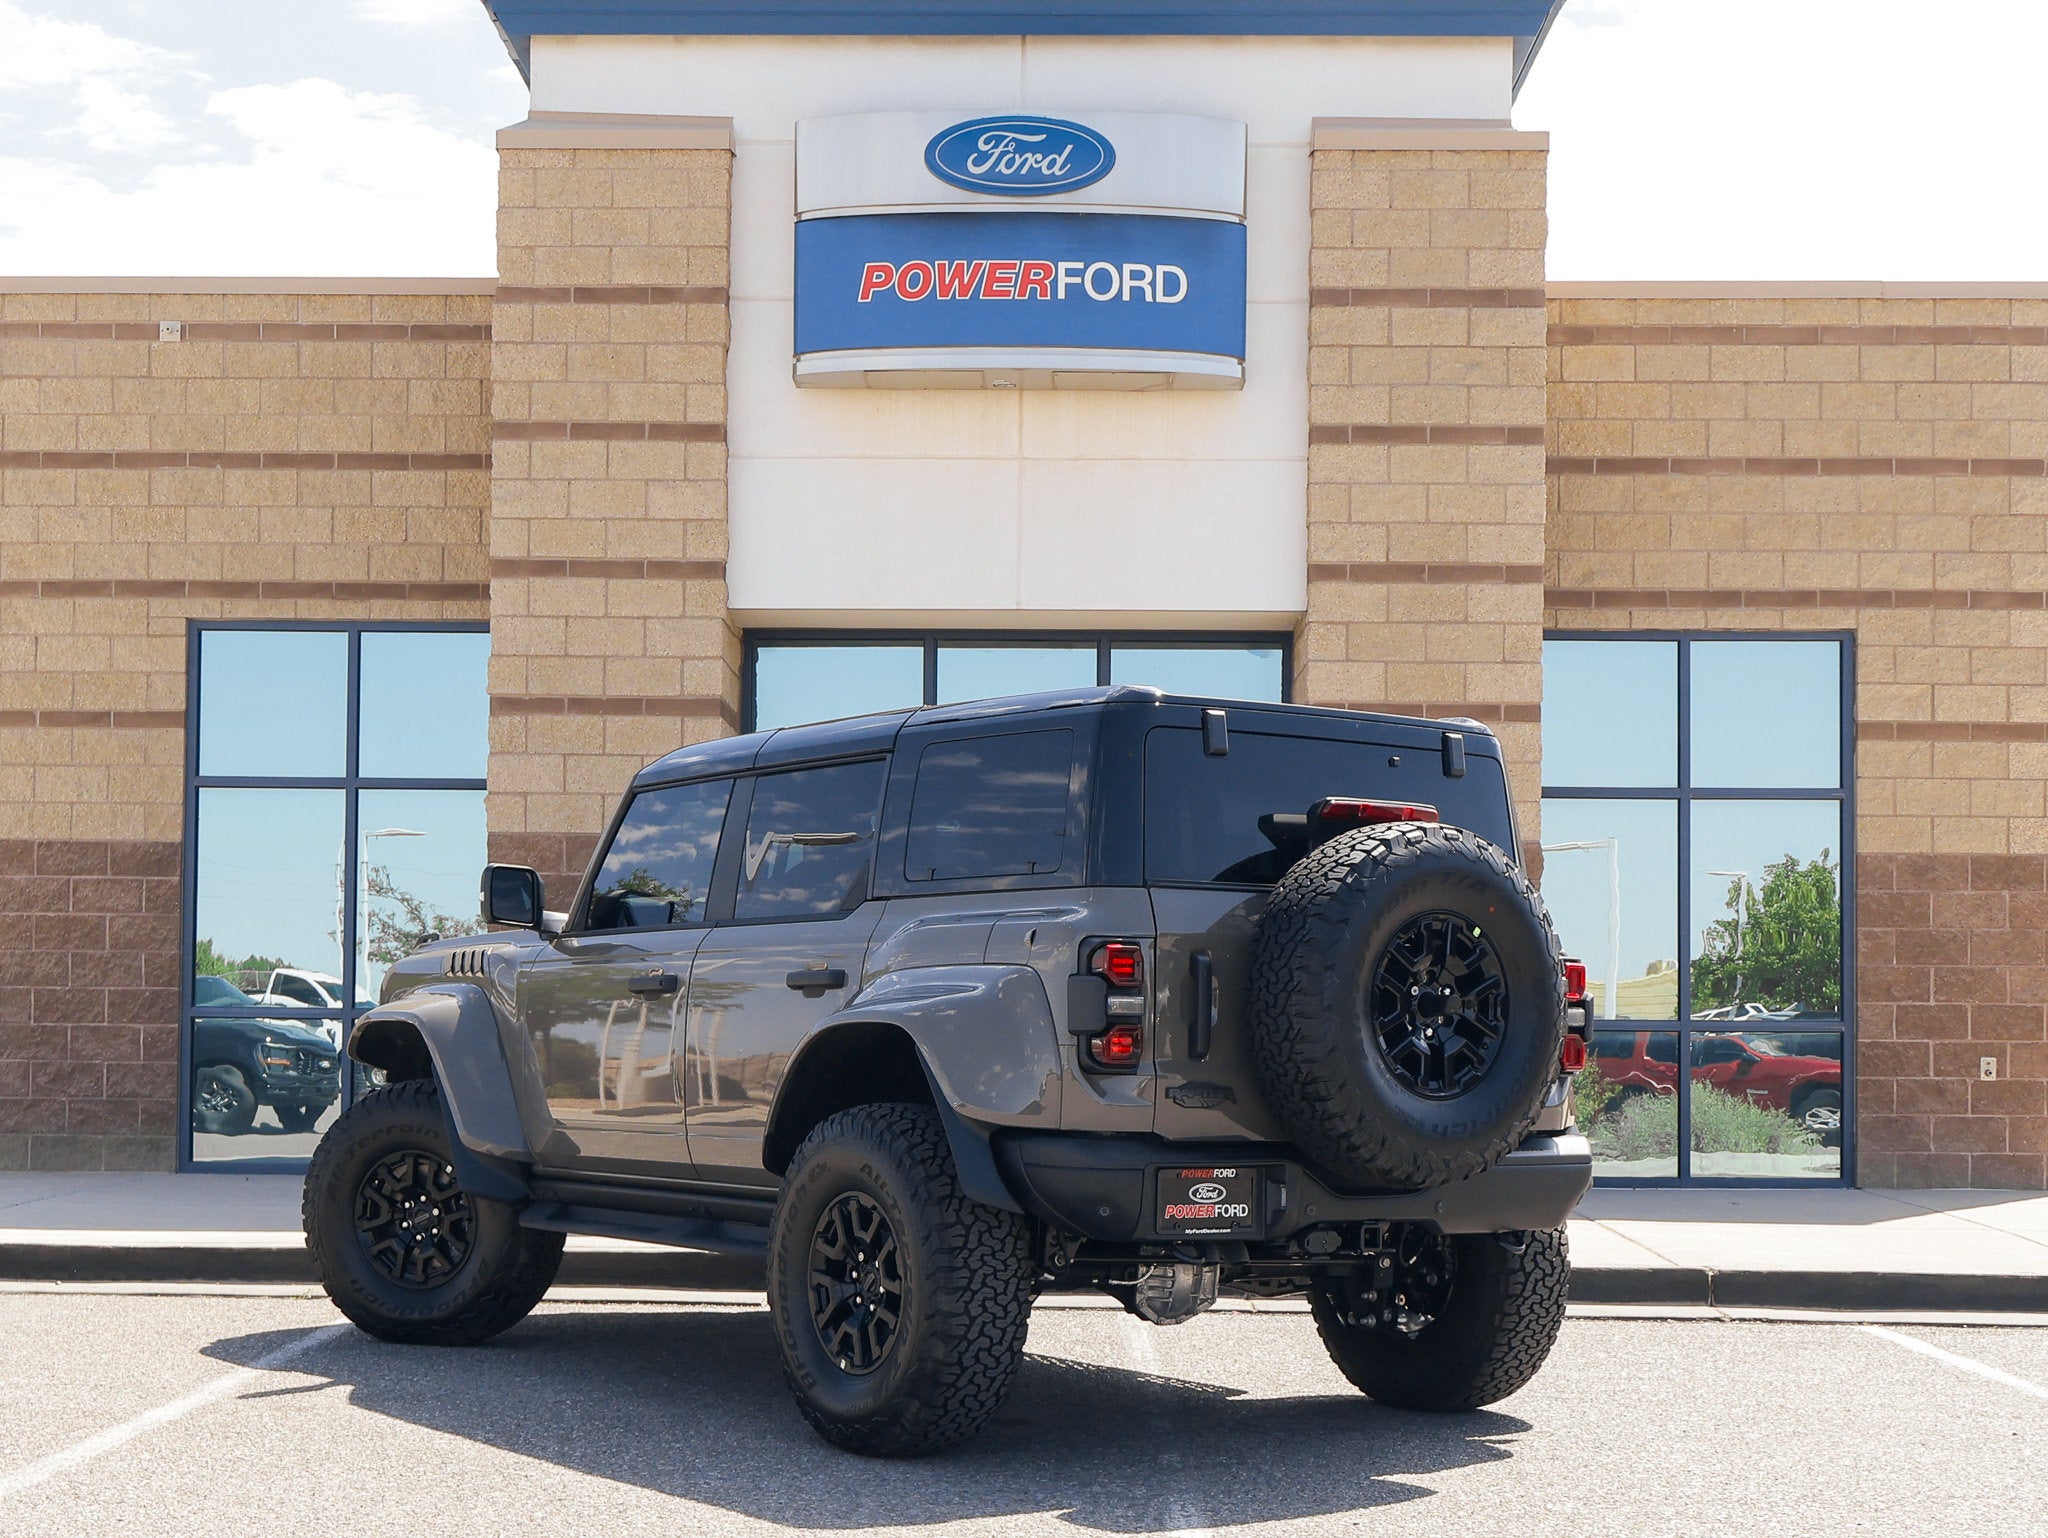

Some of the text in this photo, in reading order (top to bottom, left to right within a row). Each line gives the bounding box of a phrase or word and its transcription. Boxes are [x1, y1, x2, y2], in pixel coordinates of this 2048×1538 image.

[967, 131, 1075, 176] Ford
[858, 259, 1188, 303] POWERFORD
[1181, 1168, 1236, 1178] POWERFORD
[1196, 1186, 1219, 1199] Ford
[1164, 1204, 1249, 1219] POWERFORD
